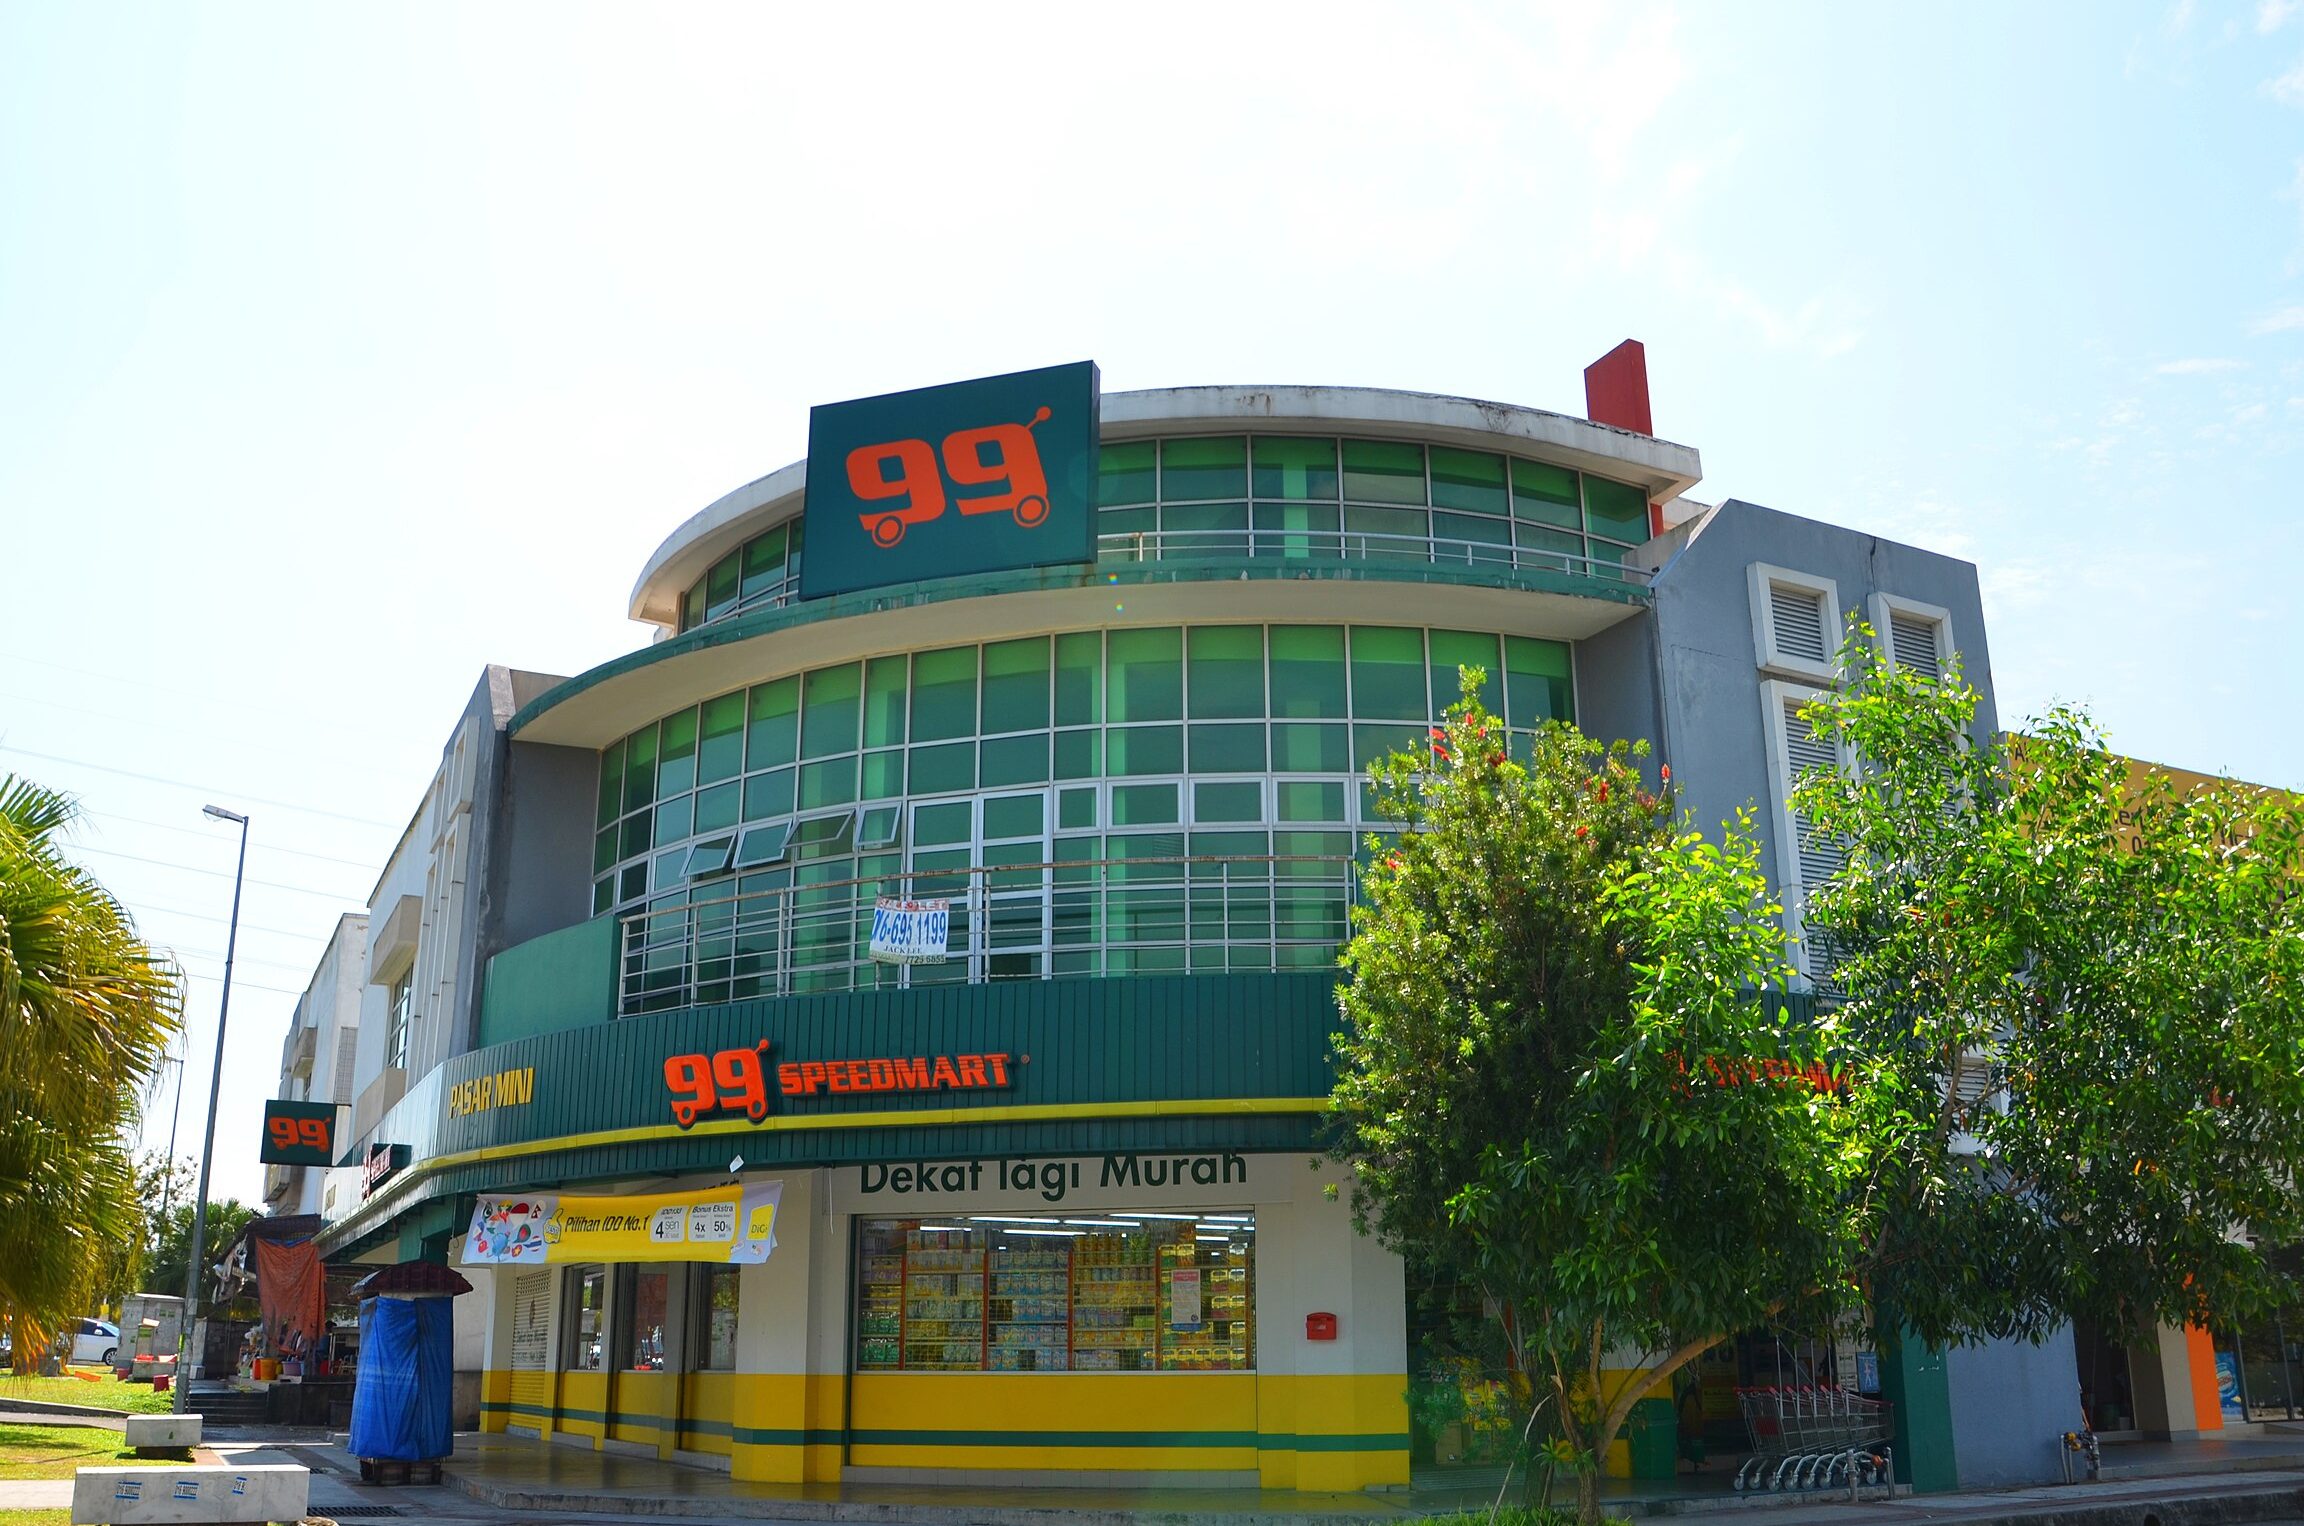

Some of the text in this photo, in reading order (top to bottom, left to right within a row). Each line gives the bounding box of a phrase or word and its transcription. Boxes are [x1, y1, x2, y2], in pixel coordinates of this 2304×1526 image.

[846, 406, 1052, 548] 99
[917, 911, 946, 945] 1199
[449, 1067, 534, 1119] PASAR MINI
[664, 1039, 1009, 1126] 99 SPEEDMART
[268, 1116, 332, 1153] 99
[861, 1161, 983, 1193] Dekat
[1100, 1154, 1247, 1187] Murah
[565, 1217, 601, 1233] Pilihan
[713, 1203, 734, 1213] Ekstra
[655, 1220, 680, 1238] 4 sen
